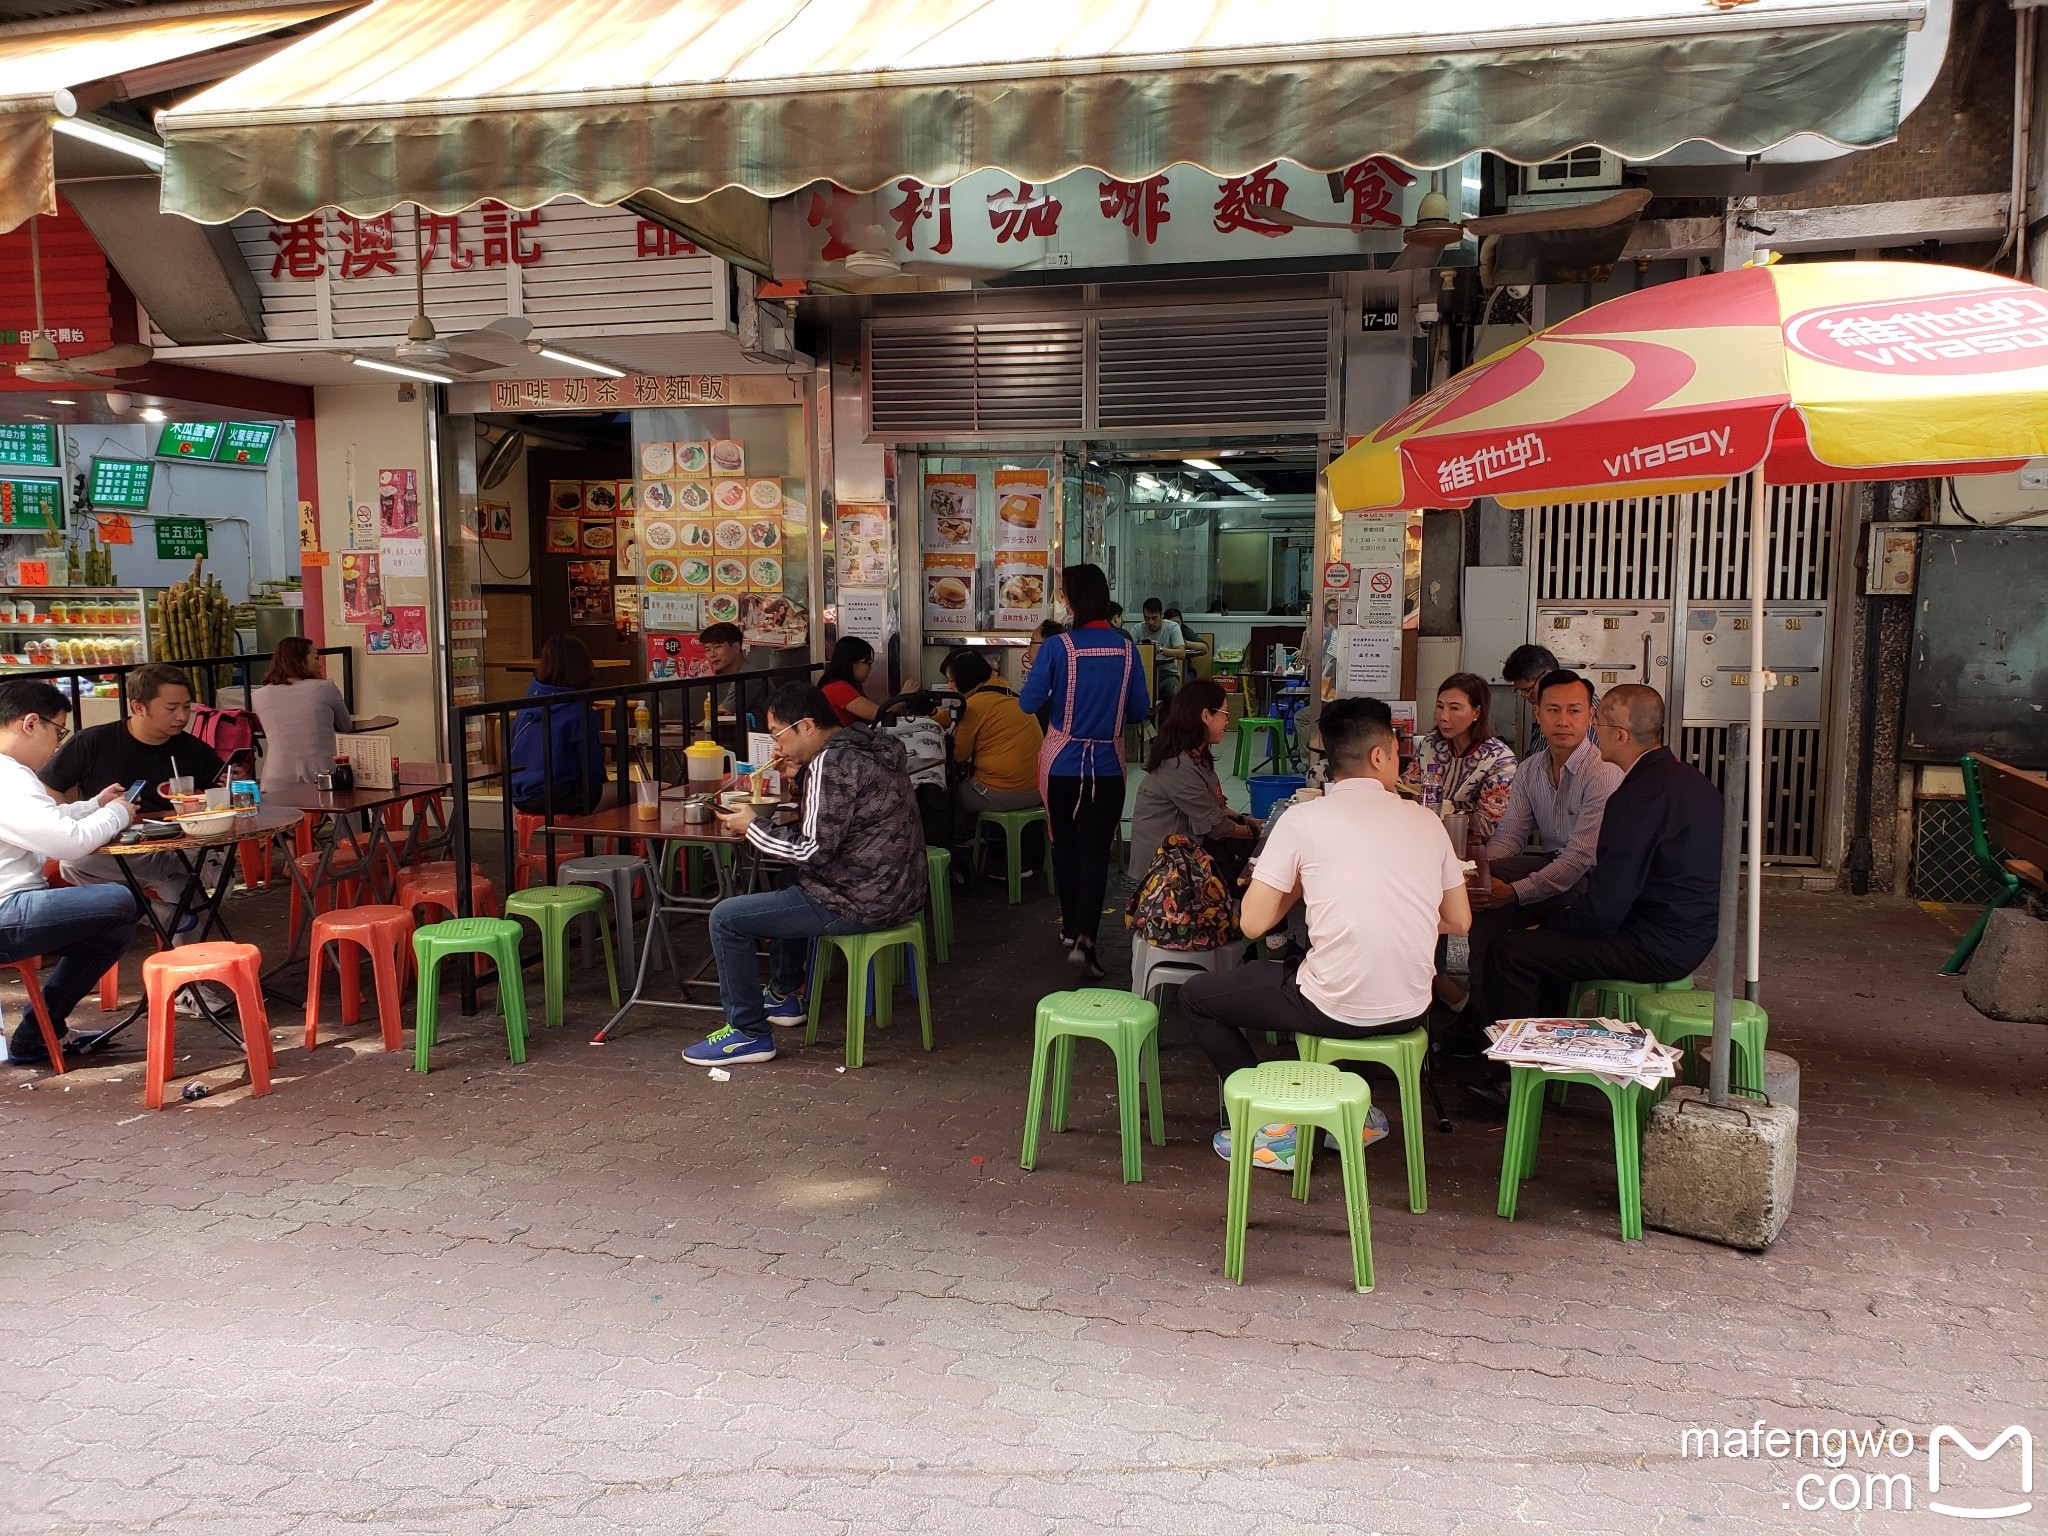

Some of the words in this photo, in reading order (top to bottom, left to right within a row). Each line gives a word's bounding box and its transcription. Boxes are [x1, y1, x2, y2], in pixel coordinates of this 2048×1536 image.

[1059, 254, 1068, 265] 72
[1853, 326, 2048, 366] vitaso
[496, 380, 551, 407] 咖啡
[565, 377, 619, 403] 奶茶
[634, 374, 724, 403] 粉麵飯
[1437, 433, 1545, 494] 維他奶
[1603, 426, 1730, 477] vitasoy
[172, 525, 204, 539] 五紅汁
